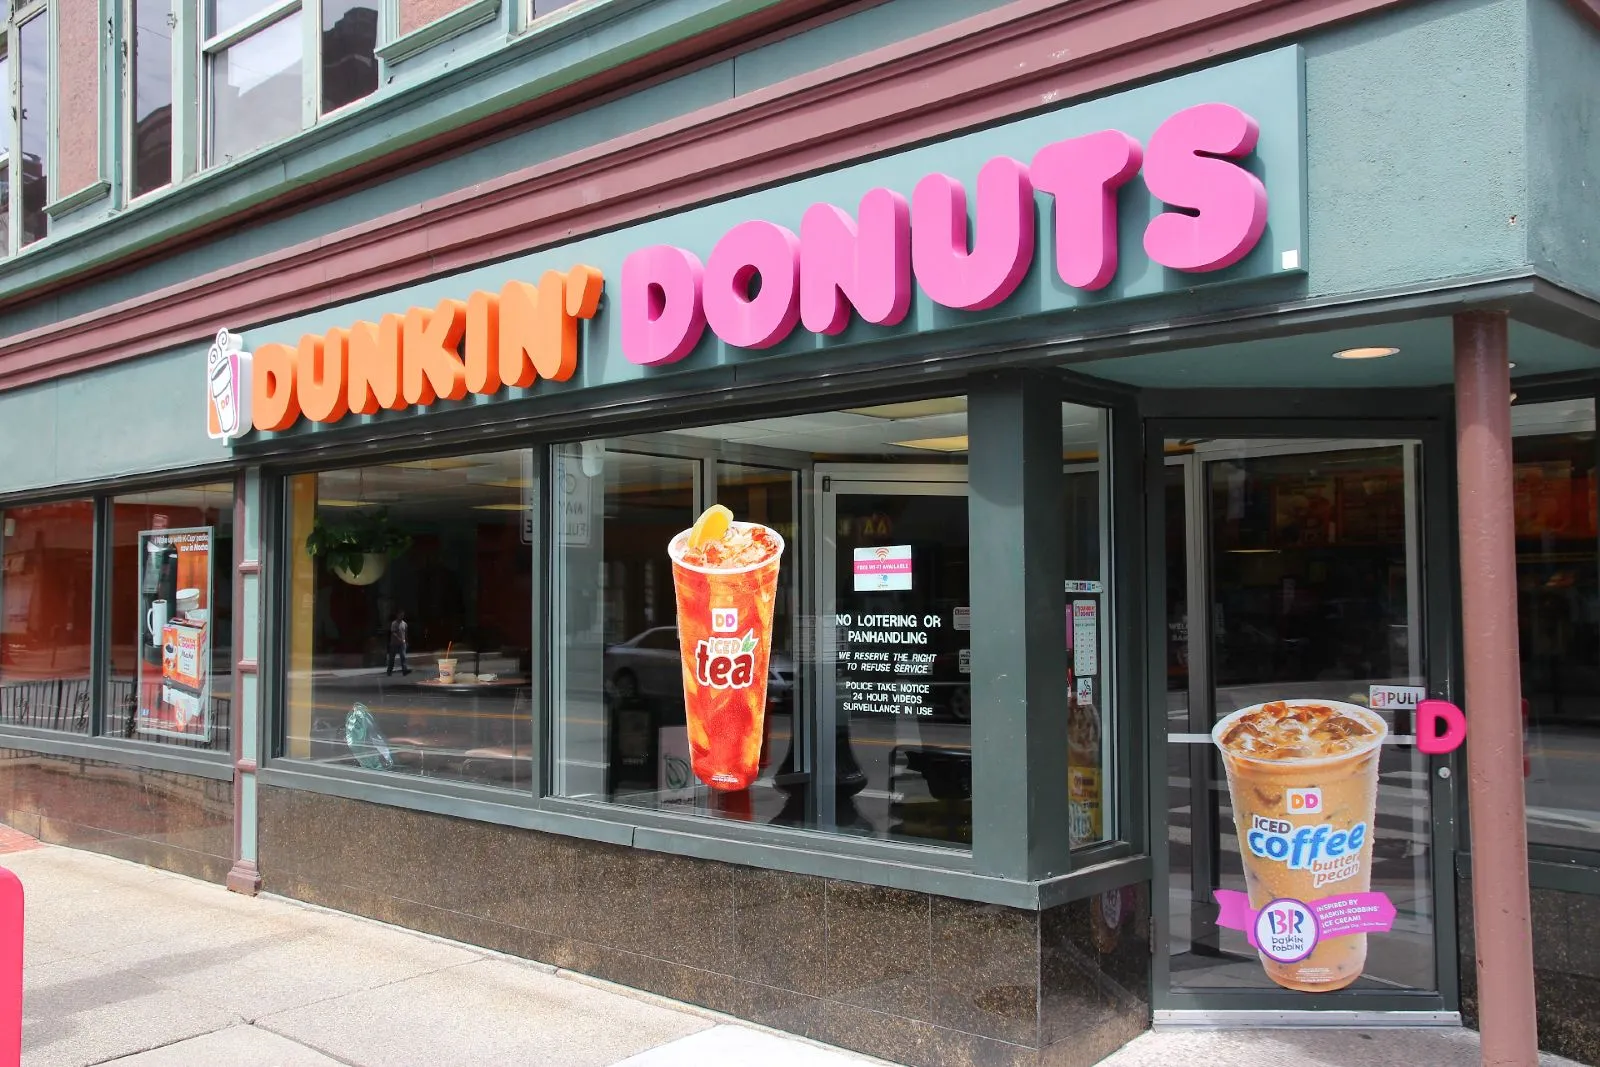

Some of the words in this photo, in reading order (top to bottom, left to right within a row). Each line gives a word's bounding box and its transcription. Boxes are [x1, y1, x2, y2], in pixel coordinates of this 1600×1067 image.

[252, 264, 604, 431] DUNKIN'
[620, 102, 1268, 366] DONUTS
[715, 613, 736, 628] DD
[836, 614, 852, 626] NO
[857, 614, 918, 628] LOITERING
[923, 615, 942, 628] OR
[847, 630, 928, 645] PANHANDLING
[709, 639, 741, 655] ICED
[697, 643, 753, 686] tea
[839, 652, 851, 660] WE
[854, 652, 889, 661] RESERVE
[893, 653, 909, 662] THE
[912, 654, 938, 663] RIGHT
[847, 662, 858, 671] TO
[860, 662, 891, 672] REFUSE
[894, 663, 929, 674] SERVICE
[845, 681, 873, 690] POLICE
[876, 682, 897, 692] TAKE
[900, 684, 930, 694] NOTICE
[852, 692, 863, 701] 24
[866, 693, 889, 702] HOUR
[892, 694, 923, 704] VIDEOS
[843, 701, 901, 714] SURVEILLANCE
[904, 706, 913, 715] IN
[916, 706, 933, 716] USE
[1416, 698, 1467, 755] D
[1291, 793, 1319, 809] DD
[1254, 817, 1292, 834] ICED
[1249, 823, 1365, 866] coffee
[1313, 853, 1361, 872] butter
[1315, 863, 1360, 885] pecan
[1316, 901, 1348, 912] INSPIRED
[1267, 909, 1305, 935] BR
[1321, 919, 1334, 929] ICE
[1271, 934, 1304, 945] baskin
[1272, 944, 1304, 952] robbins
